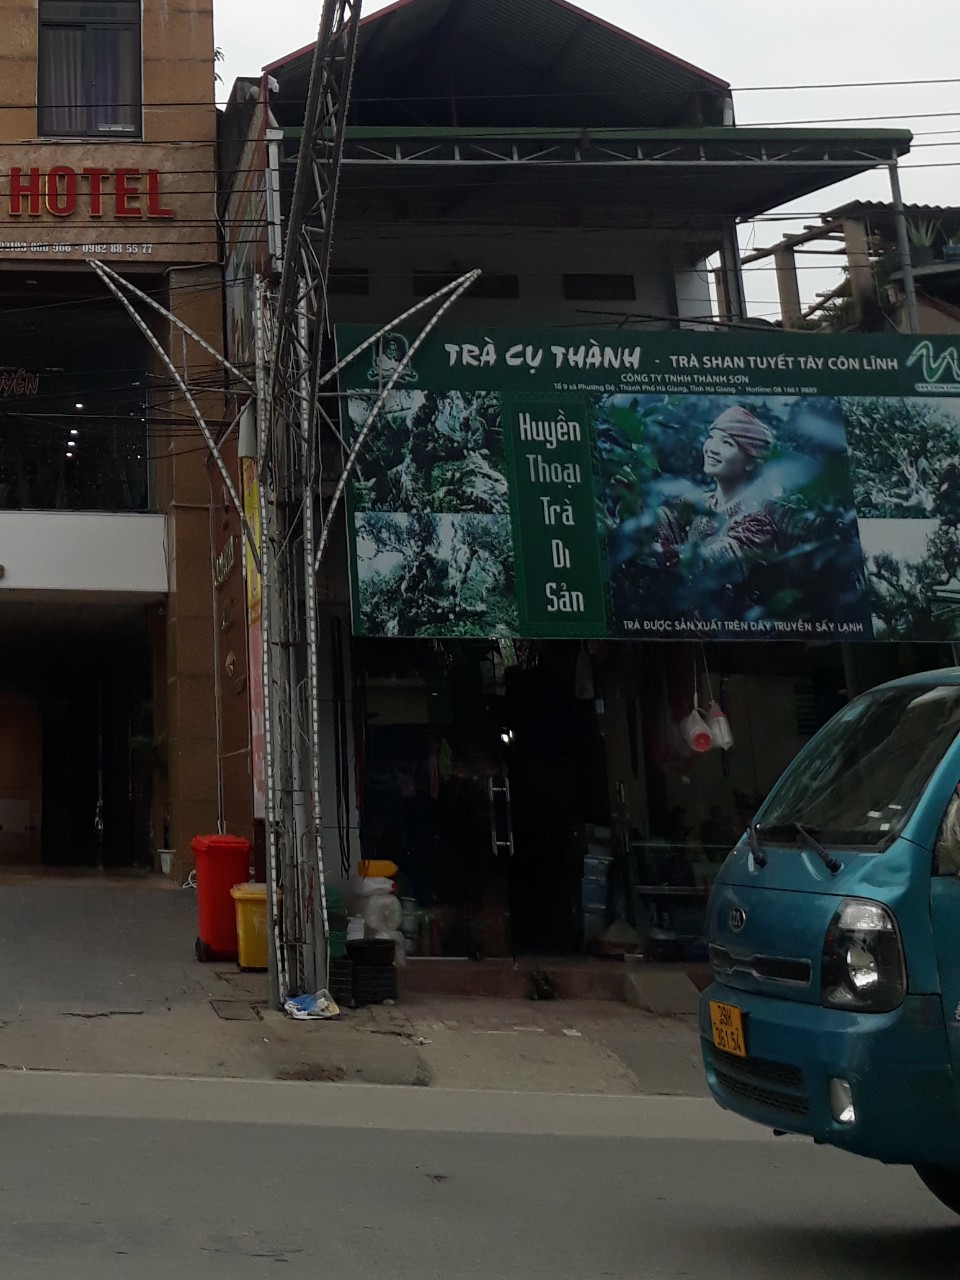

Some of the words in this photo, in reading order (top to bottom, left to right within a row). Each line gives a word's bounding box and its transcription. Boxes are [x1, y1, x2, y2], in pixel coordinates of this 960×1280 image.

[8, 166, 174, 219] HOTEL
[82, 243, 107, 253] 0982
[110, 243, 123, 253] 88
[126, 244, 138, 254] 55
[142, 244, 152, 254] 77
[444, 336, 497, 367] TRÀ
[505, 343, 543, 374] CỤ
[550, 338, 641, 369] THÀNH
[669, 353, 699, 368] TRÀ
[702, 355, 744, 369] SHAN
[747, 353, 794, 370] TUYẾT
[799, 354, 825, 370] TÂY
[828, 354, 859, 370] CÔN
[863, 355, 898, 370] LĨNH
[620, 372, 648, 382] CÔNG
[650, 373, 662, 383] TY
[664, 373, 690, 383] TNHH
[693, 373, 727, 384] THÀNH
[729, 374, 749, 384] SƠN
[715, 385, 736, 394] Giang
[518, 408, 581, 450] Huyền
[526, 454, 581, 489] Thoại
[540, 496, 575, 525] Trà
[551, 538, 571, 568] Di
[545, 582, 584, 612] Sản
[623, 618, 640, 630] TRÀ
[674, 617, 695, 631] SẢN
[723, 618, 748, 631] TRÊN
[750, 619, 772, 631] DÂY
